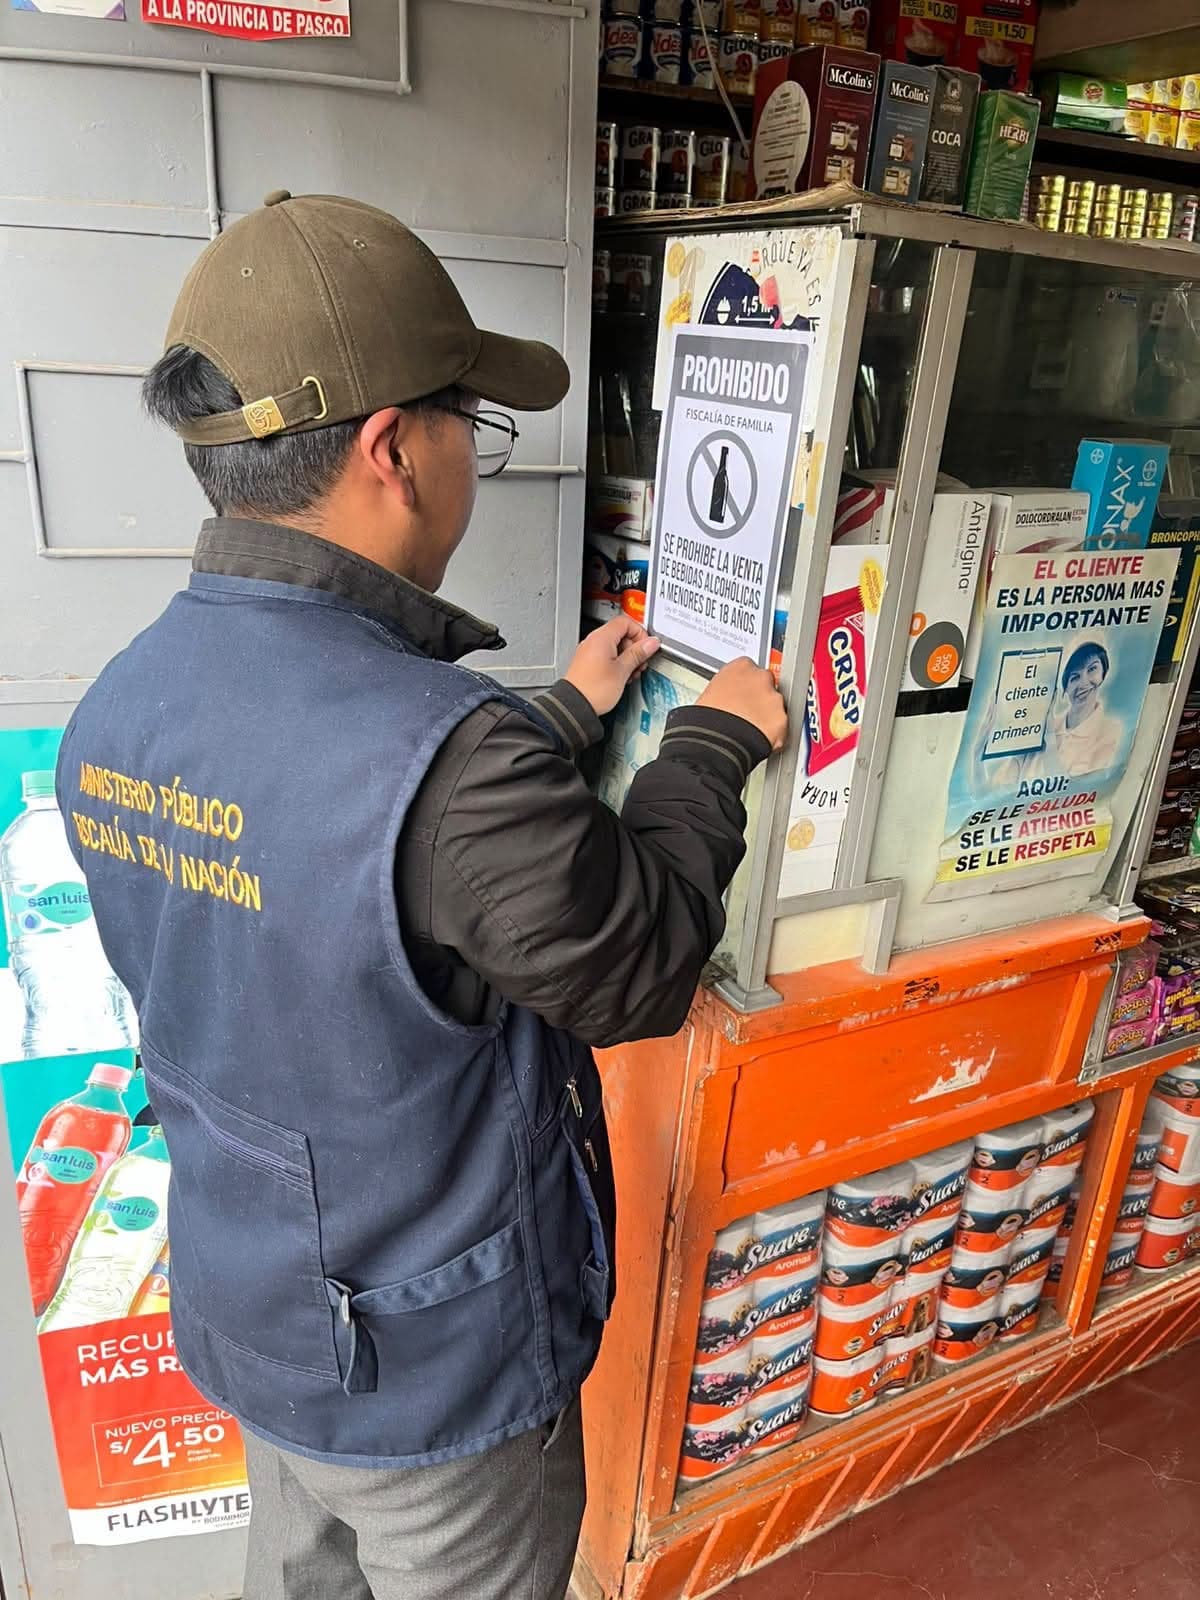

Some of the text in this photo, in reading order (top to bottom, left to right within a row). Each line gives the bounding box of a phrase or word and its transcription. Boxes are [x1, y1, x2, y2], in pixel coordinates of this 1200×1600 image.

[148, 0, 344, 36] A LA PROVINCIA DE PASCO
[829, 68, 873, 90] McColin's
[890, 81, 930, 103] McColin's
[931, 130, 961, 147] COCA
[681, 354, 790, 405] PROHIBIDO
[685, 406, 774, 434] FISCALÍA DE FAMILIA
[663, 532, 763, 586] SE PROHIBE LA VENTA
[958, 500, 986, 591] Antalgina
[1034, 556, 1144, 580] EL CLIENTE
[660, 556, 761, 610] DE BEBIDAS ALCOHÓLICAS
[997, 579, 1166, 608] ES LA PERSONA MAS
[659, 579, 665, 599] A
[666, 581, 704, 614] MENORES
[705, 597, 717, 619] DE
[719, 603, 729, 624] 18
[730, 605, 757, 636] AÑOS.
[1001, 605, 1152, 634] IMPORTANTE
[829, 629, 860, 725] CRISP
[943, 652, 953, 675] 500
[1025, 665, 1037, 679] El
[1005, 685, 1048, 701] cliente
[1014, 708, 1027, 718] es
[992, 723, 1041, 743] primero
[80, 760, 243, 841] MINISTERIO PÚBLICO
[1017, 775, 1070, 798] AQUI:
[968, 791, 1097, 826] SE LE SALUDA
[960, 809, 1096, 849] SE LE ATIENDE
[72, 811, 136, 863] FISCALÍA
[180, 855, 261, 912] NACIÓN
[955, 831, 1096, 872] SE LE RESPETA
[28, 891, 89, 908] san luis
[40, 1150, 95, 1171] san luis
[105, 1199, 156, 1218] san luis
[744, 1228, 810, 1274] Suave
[774, 1254, 812, 1272] Aromas
[739, 1288, 802, 1338] Suave
[768, 1315, 805, 1332] Aromas
[80, 1355, 183, 1387] MÁS R
[105, 1410, 233, 1439] NUEVO PRECIO
[107, 1493, 250, 1531] FLASHLYTE
